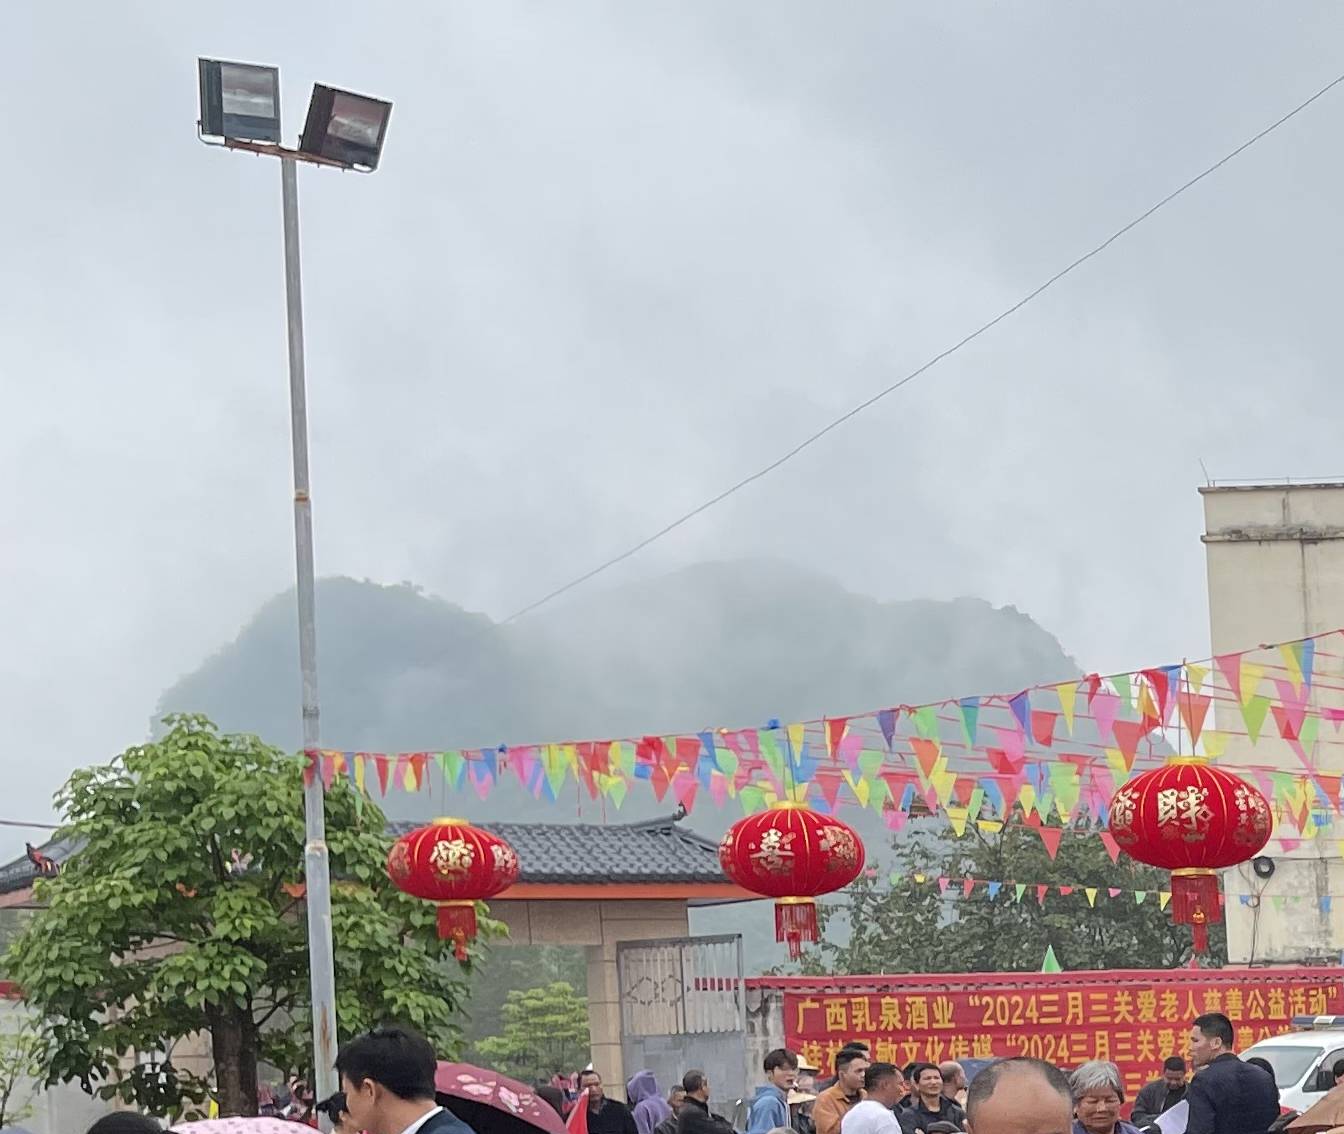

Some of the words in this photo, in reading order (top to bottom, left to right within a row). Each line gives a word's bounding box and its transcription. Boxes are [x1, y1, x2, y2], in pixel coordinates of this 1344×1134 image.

[796, 994, 956, 1033] 广西乳泉酒业
[968, 987, 1337, 1027] “2024三月三关爱老人慈善公益活动”
